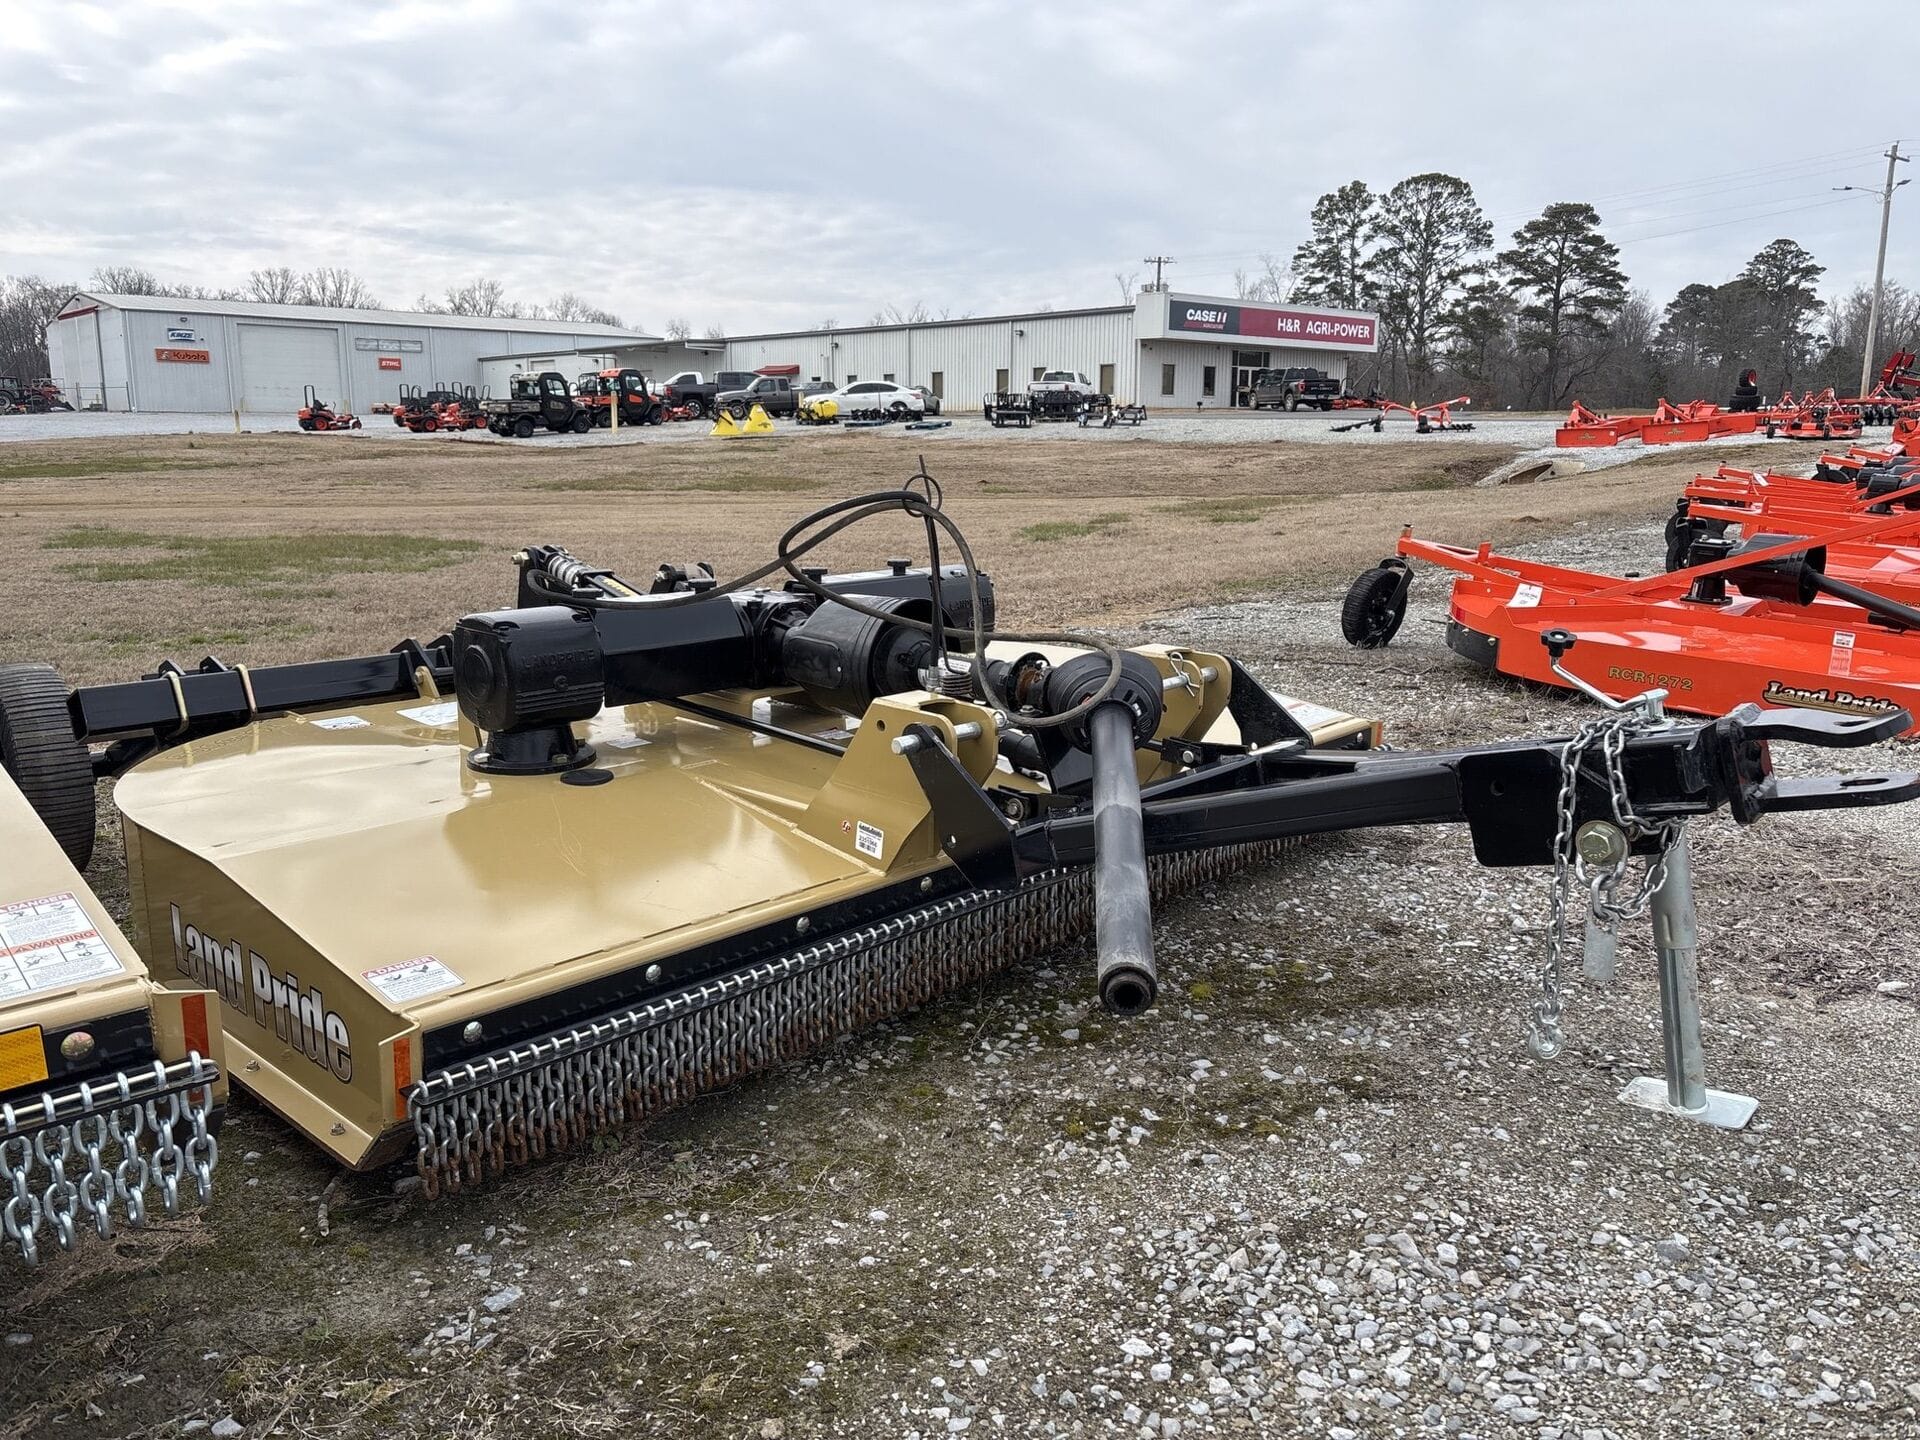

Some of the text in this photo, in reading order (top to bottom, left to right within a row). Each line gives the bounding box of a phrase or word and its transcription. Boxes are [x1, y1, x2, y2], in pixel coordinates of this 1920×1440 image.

[1186, 308, 1217, 322] CASE
[1277, 317, 1370, 339] H&R AGRI-POWER
[173, 351, 207, 361] Kubota
[1608, 666, 1693, 691] RCR1272
[1766, 681, 1899, 714] Land Pride
[8, 893, 69, 912] DANGER
[29, 930, 95, 949] WARNING
[377, 956, 433, 975] DANGER
[170, 901, 352, 1084] Land Pride
